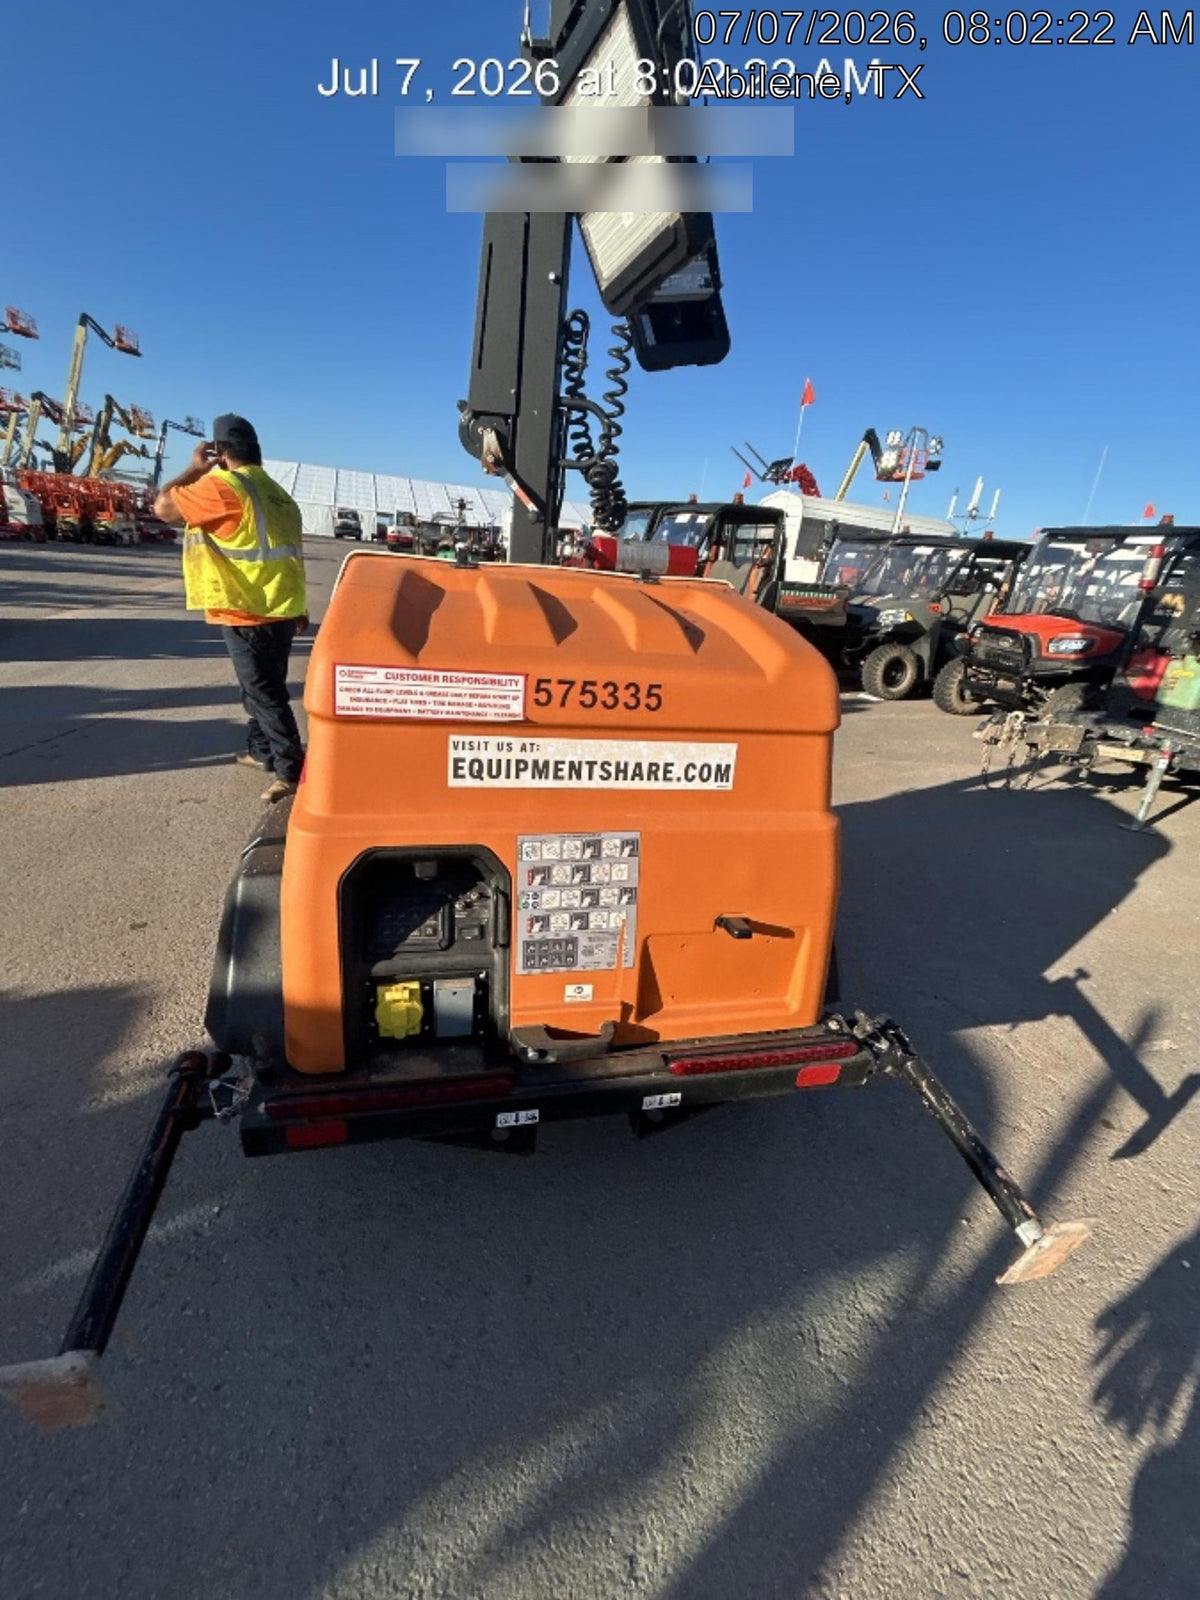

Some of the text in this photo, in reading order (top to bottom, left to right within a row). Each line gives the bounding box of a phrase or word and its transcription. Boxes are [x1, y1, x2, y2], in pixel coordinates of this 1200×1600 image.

[384, 671, 440, 683] CUSTOMER
[442, 674, 520, 688] RESPONSIBILITY
[534, 679, 663, 712] 575335
[452, 740, 540, 752] VISIT US AT:
[452, 757, 731, 783] EQUIPMENTSHARE.COM
